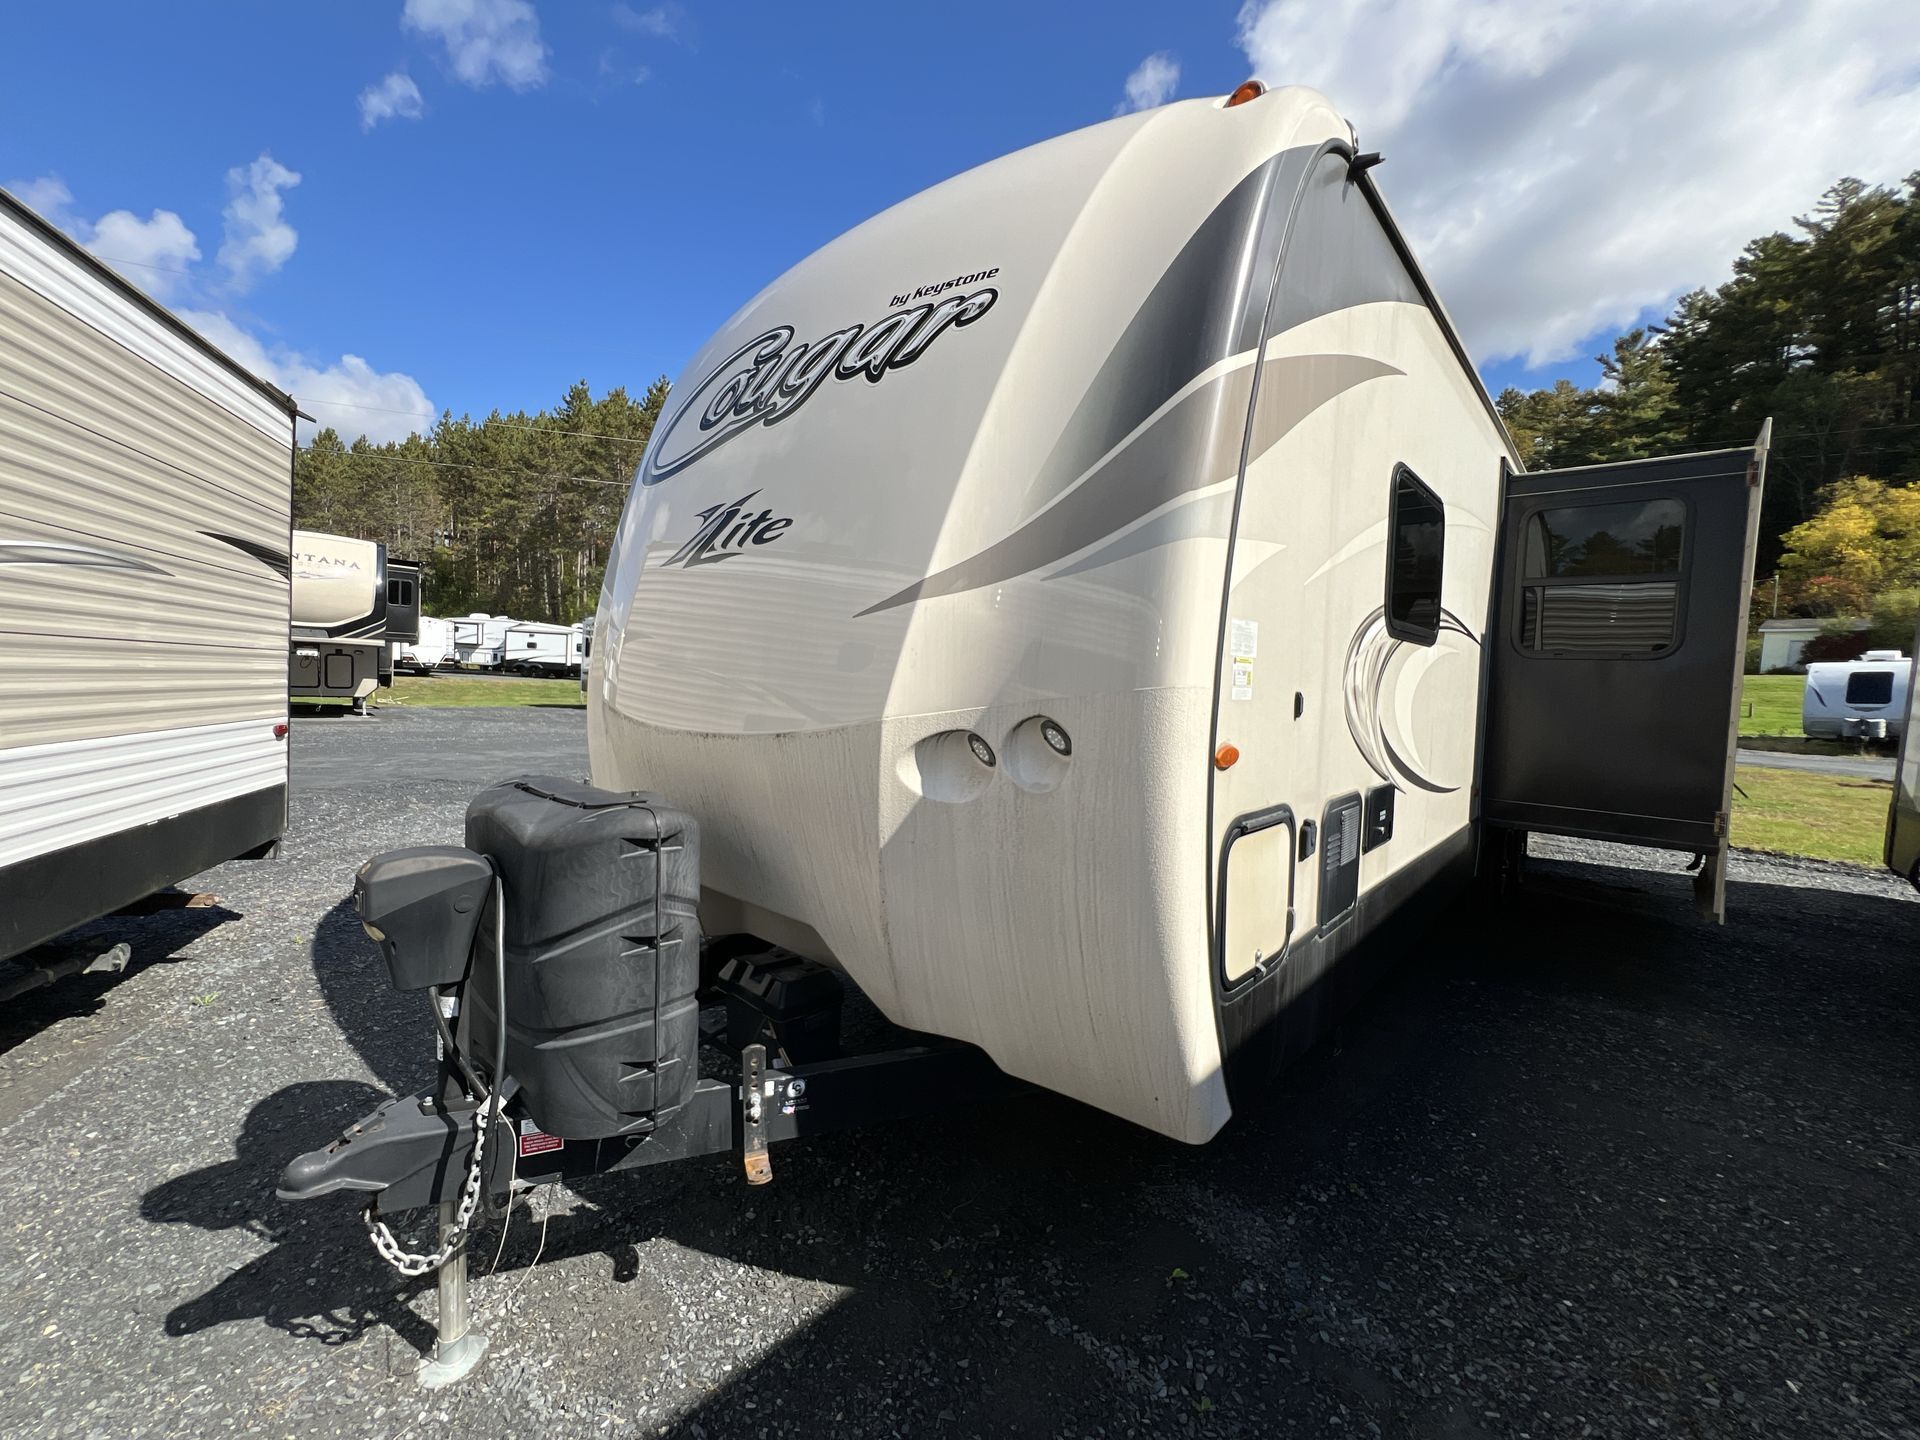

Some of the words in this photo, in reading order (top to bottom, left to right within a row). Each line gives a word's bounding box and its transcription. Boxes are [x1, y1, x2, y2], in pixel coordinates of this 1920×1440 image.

[889, 292, 911, 307] by
[912, 268, 999, 300] Keystone
[642, 288, 999, 487] Cougar
